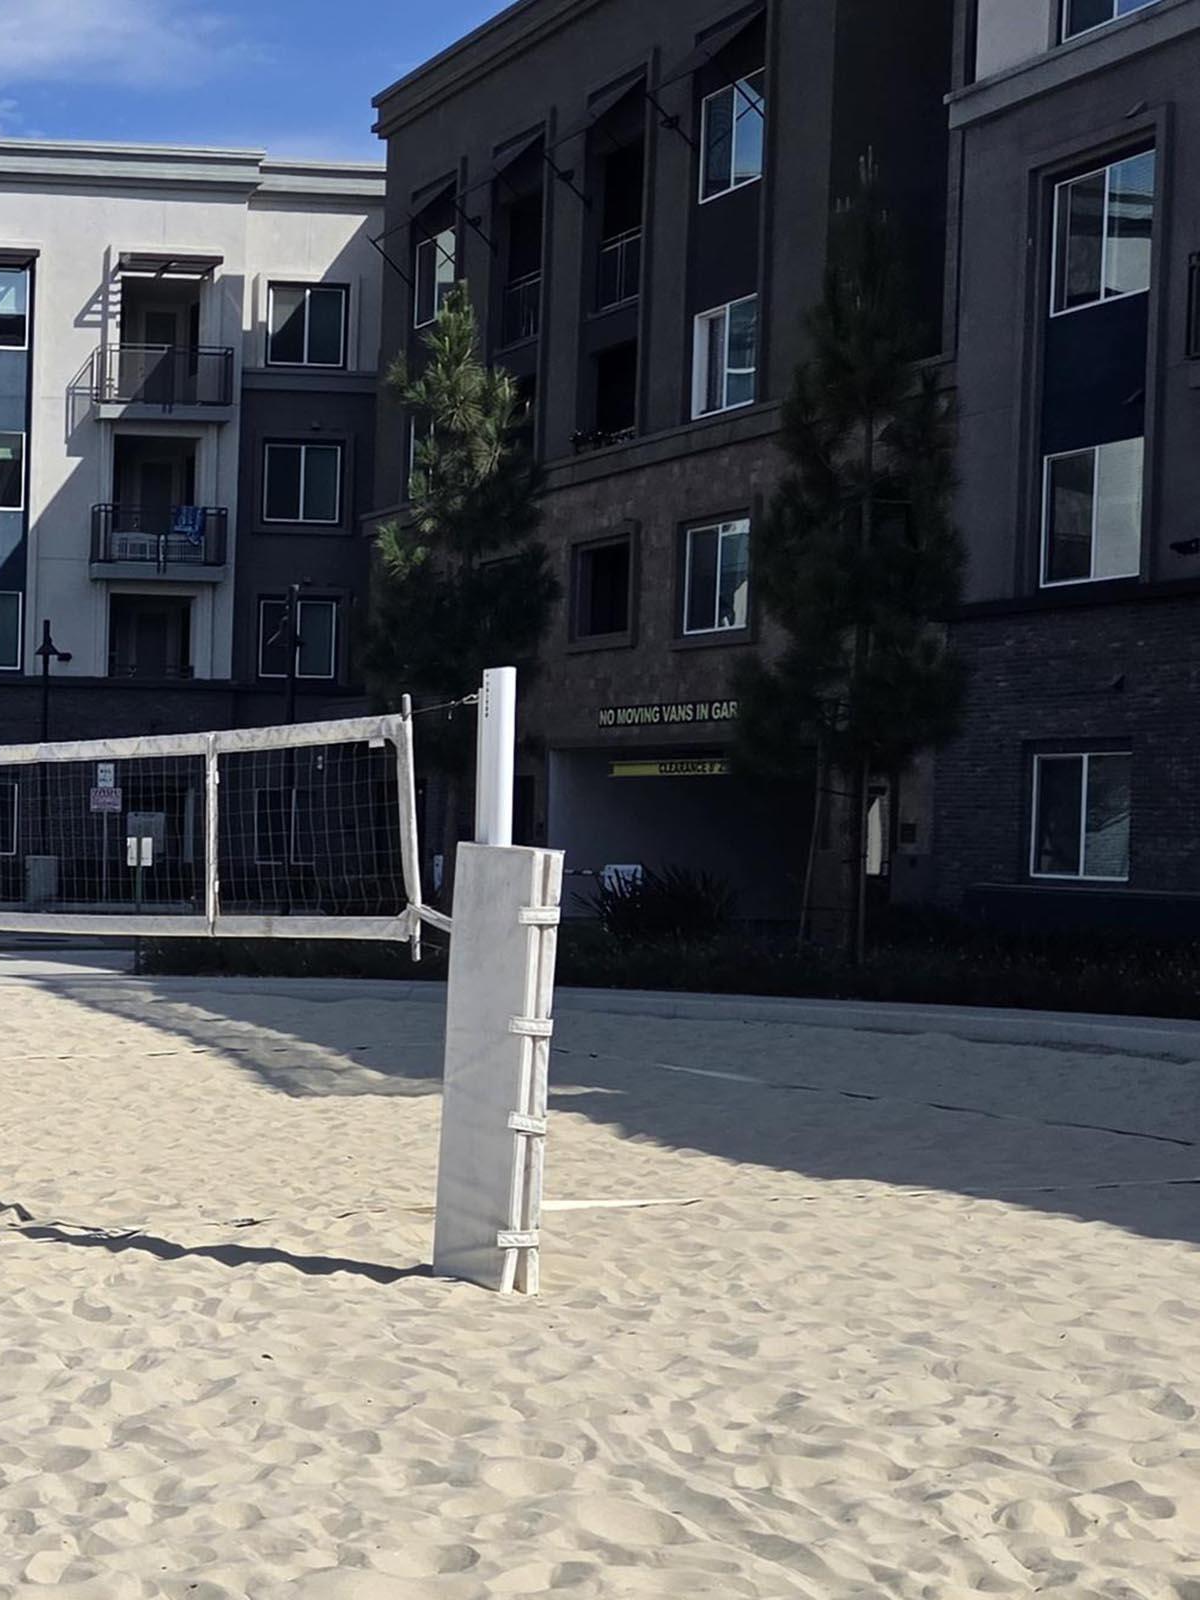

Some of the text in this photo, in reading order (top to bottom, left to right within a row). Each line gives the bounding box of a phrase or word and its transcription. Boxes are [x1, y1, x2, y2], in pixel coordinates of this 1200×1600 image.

[599, 708, 615, 726] NO
[616, 706, 660, 724] MOVING
[662, 703, 694, 722] VANS
[696, 703, 709, 720] IN
